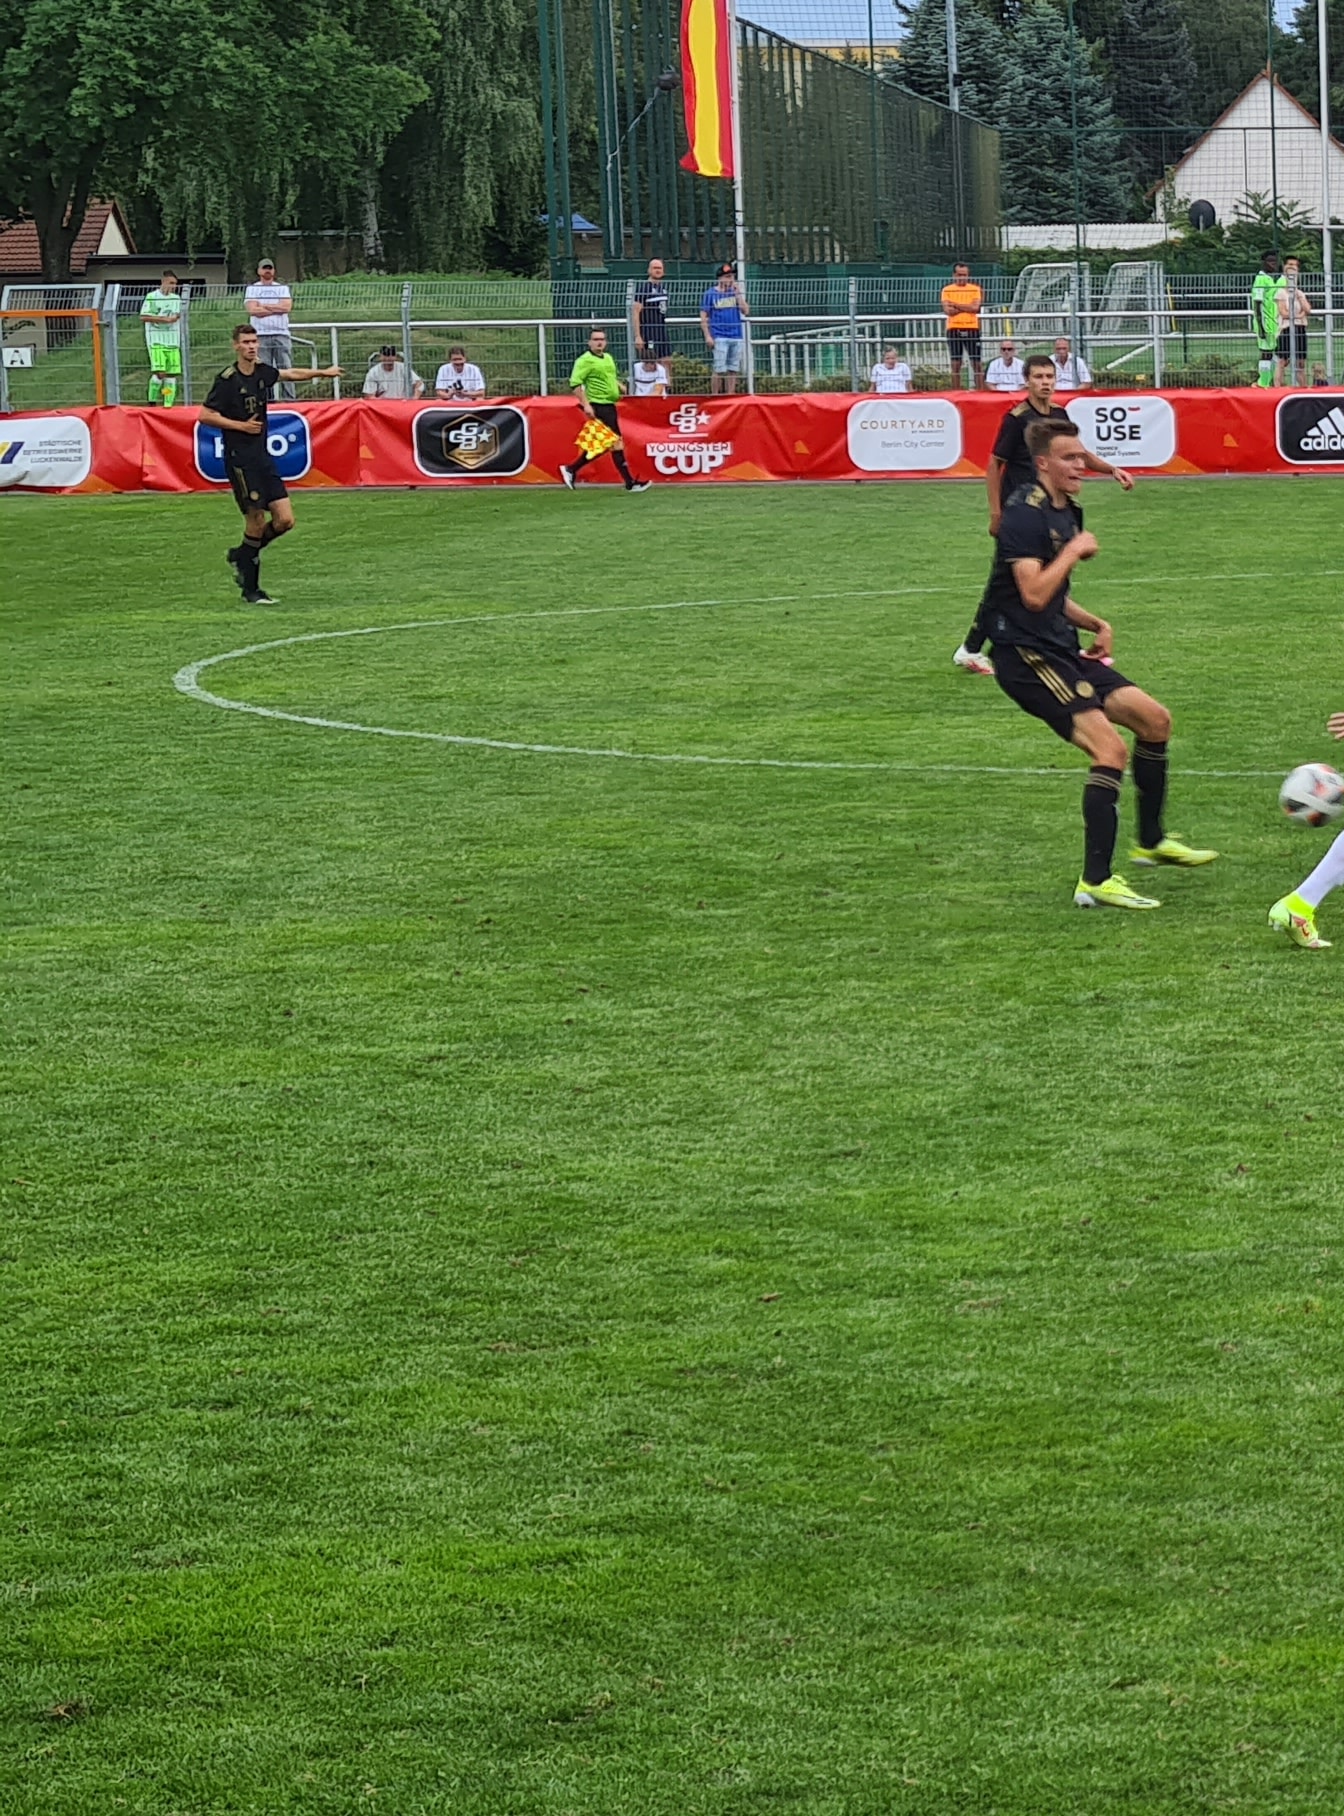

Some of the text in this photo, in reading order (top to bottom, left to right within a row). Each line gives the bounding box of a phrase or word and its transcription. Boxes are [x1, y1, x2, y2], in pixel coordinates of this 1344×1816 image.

[9, 349, 25, 365] A
[1095, 407, 1127, 423] SO
[860, 419, 945, 430] COURTYARD
[1096, 424, 1141, 442] USE
[648, 442, 729, 454] YOUNGSTER
[904, 440, 918, 449] City
[655, 453, 725, 475] CUP
